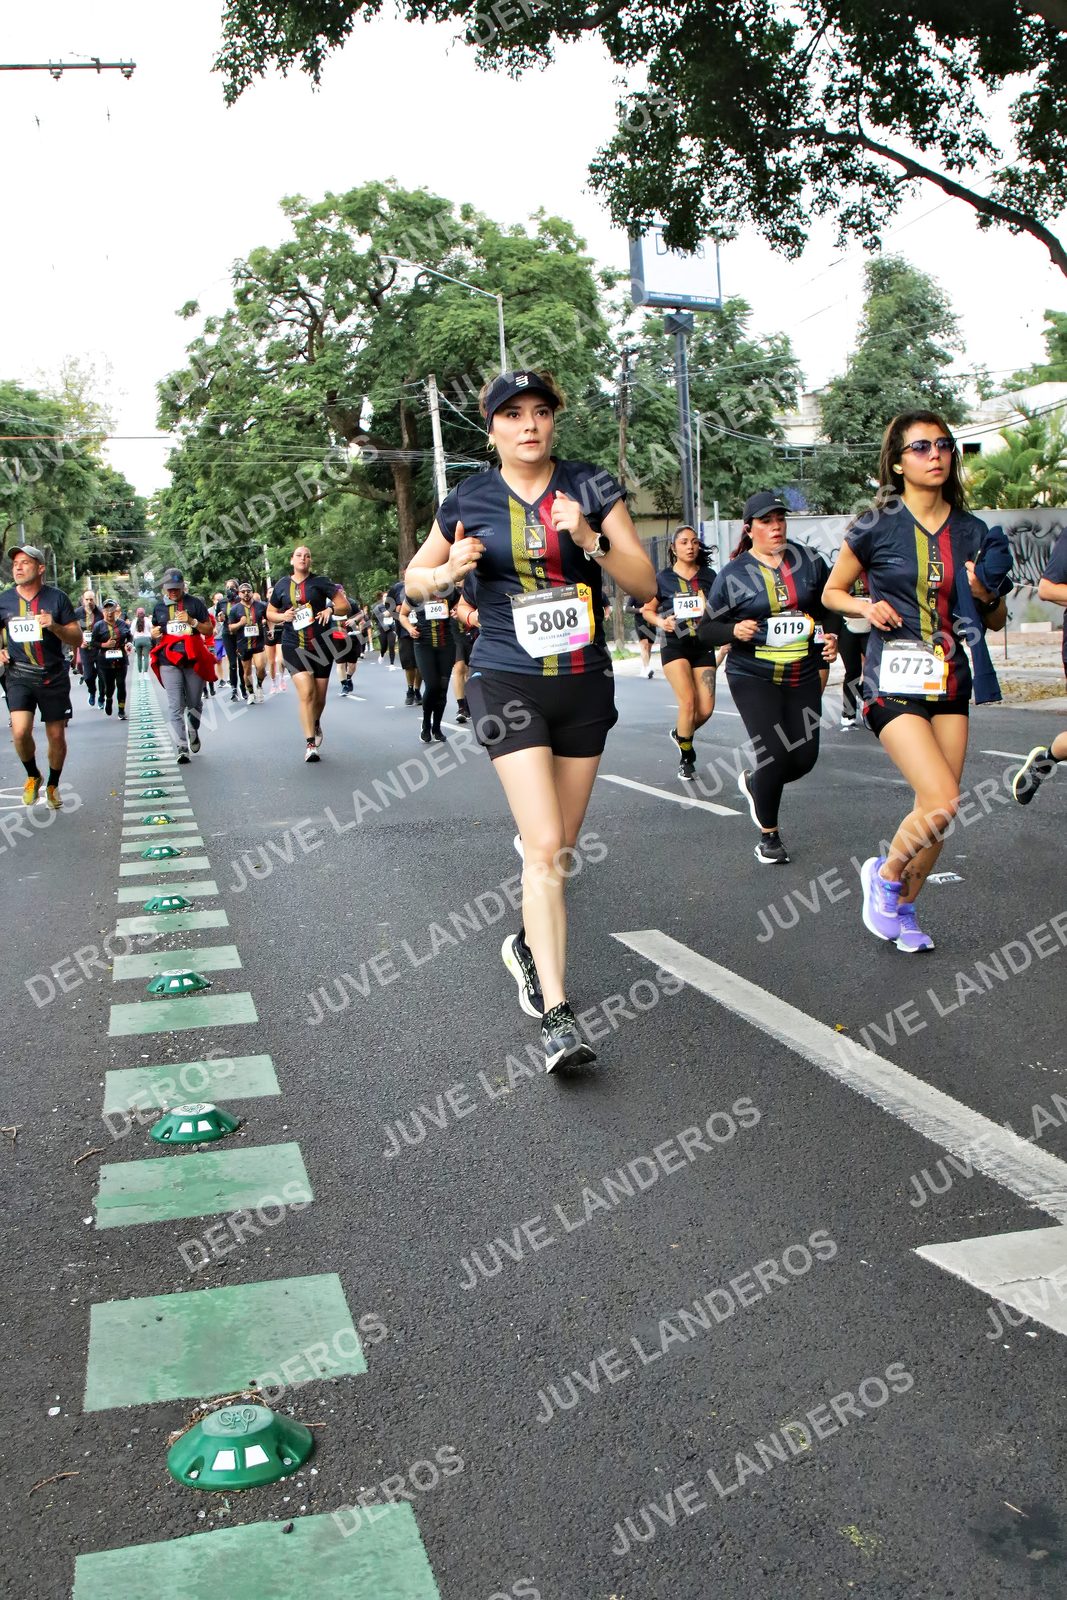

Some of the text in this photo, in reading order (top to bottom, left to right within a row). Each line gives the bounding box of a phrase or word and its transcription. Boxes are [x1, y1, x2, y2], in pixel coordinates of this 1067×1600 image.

[430, 605, 442, 613] 260
[677, 599, 699, 610] 7481
[526, 607, 579, 635] 5808
[13, 623, 35, 633] 5102
[774, 622, 804, 634] 6119
[889, 657, 934, 676] 6773
